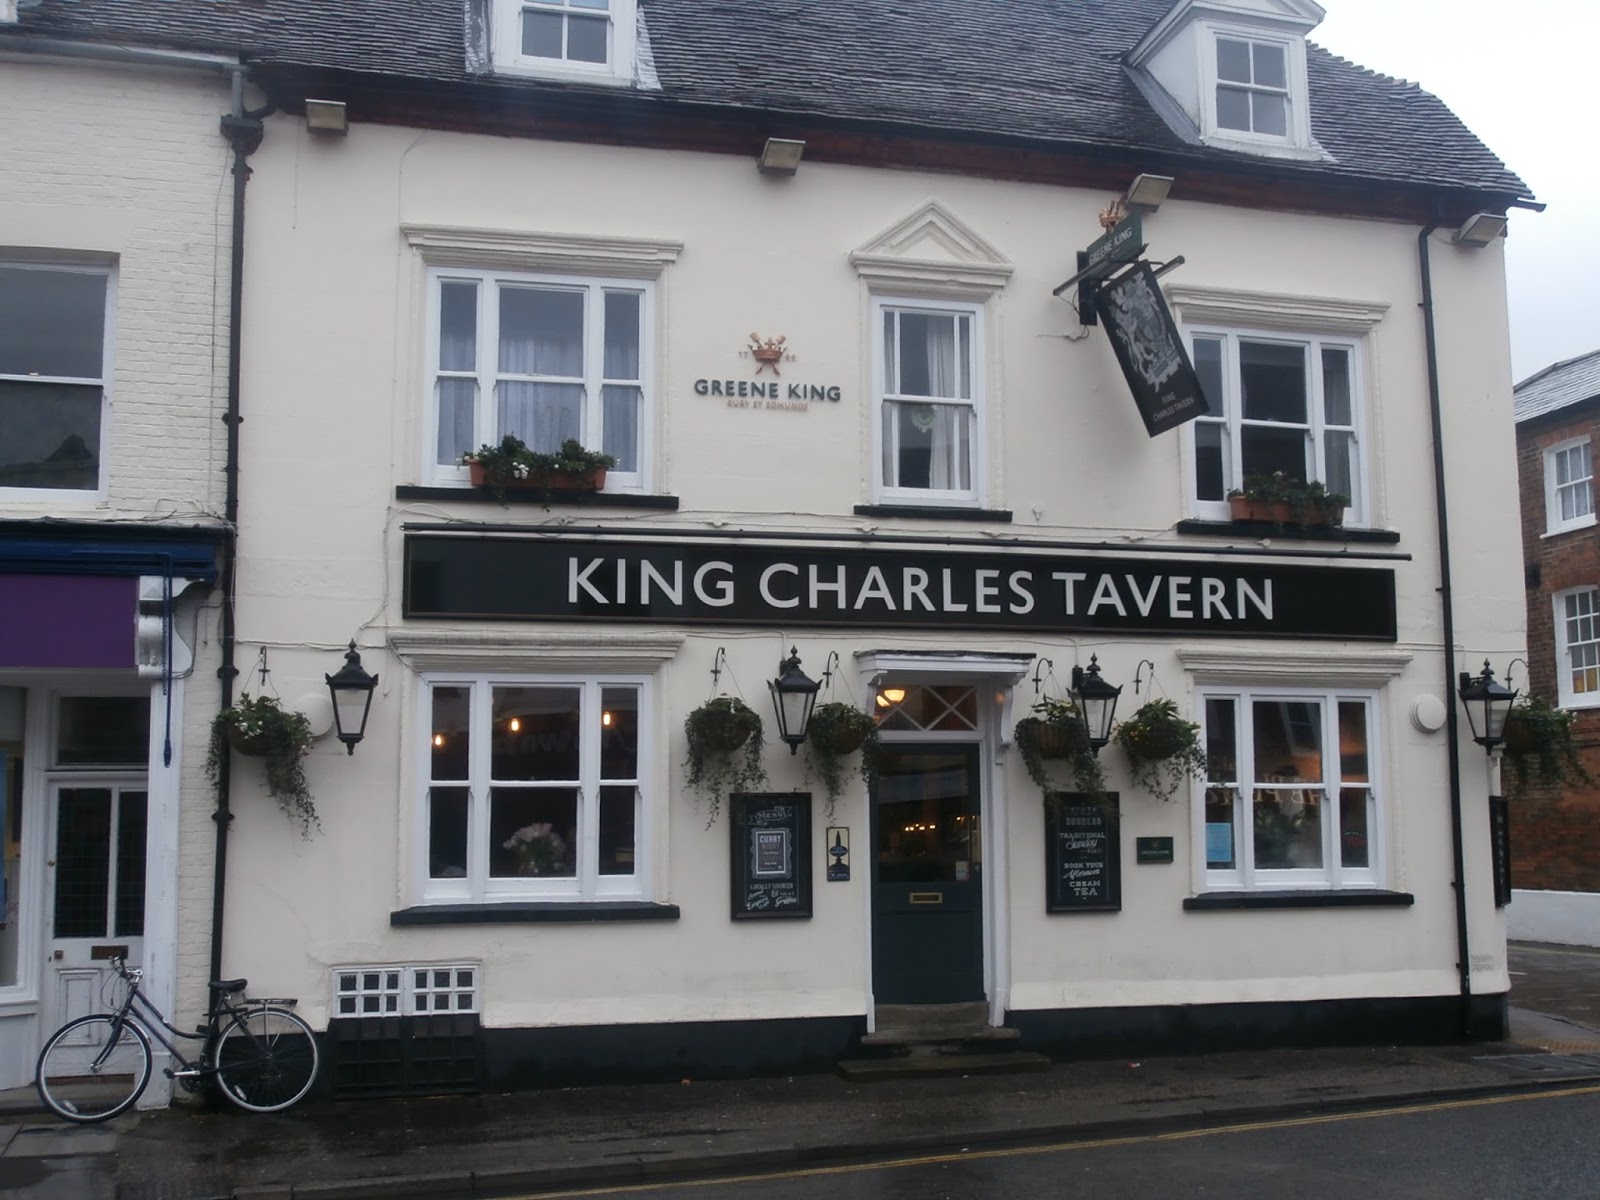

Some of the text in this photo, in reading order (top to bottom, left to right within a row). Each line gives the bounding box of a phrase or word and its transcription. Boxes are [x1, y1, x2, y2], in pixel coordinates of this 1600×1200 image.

[1114, 227, 1132, 246] KING
[694, 379, 841, 402] GREENE KING
[727, 400, 749, 408] BURY
[766, 401, 808, 411] EDMUNDS
[568, 557, 1273, 620] KING CHARLES TAVERN
[760, 835, 781, 843] CURRY
[1074, 887, 1098, 896] TEA
